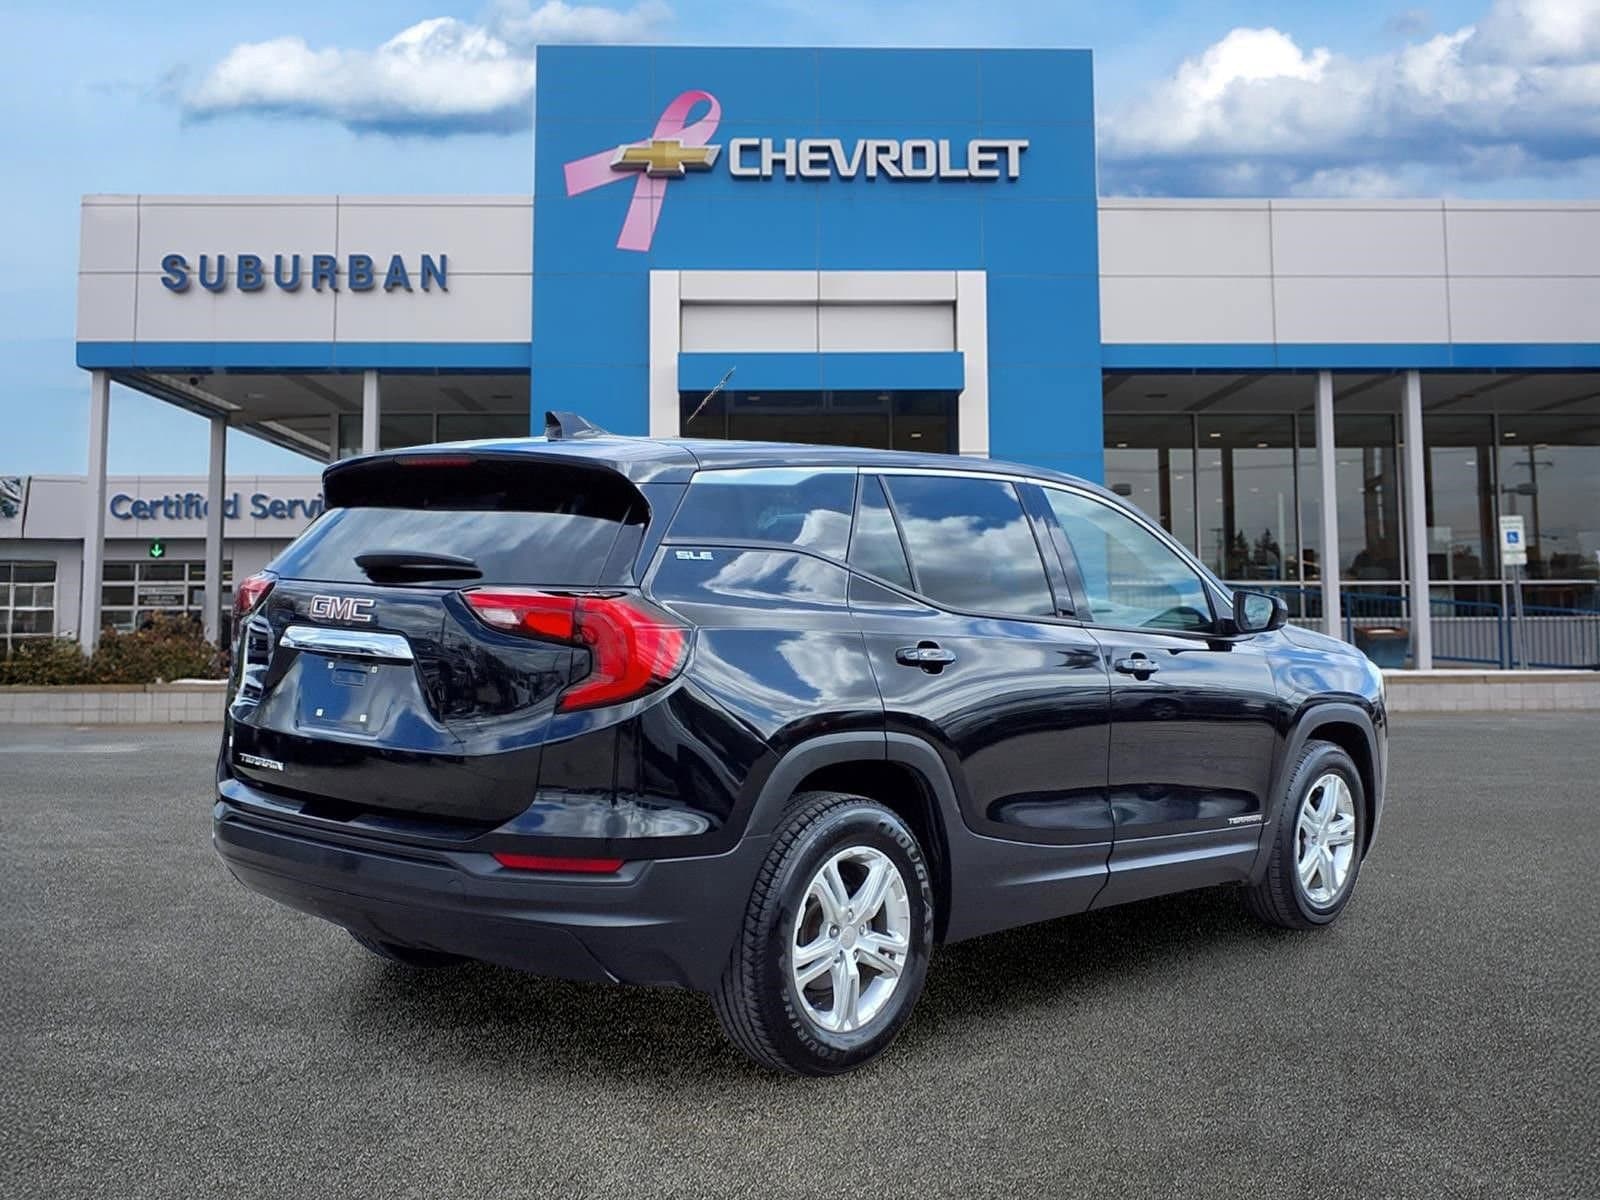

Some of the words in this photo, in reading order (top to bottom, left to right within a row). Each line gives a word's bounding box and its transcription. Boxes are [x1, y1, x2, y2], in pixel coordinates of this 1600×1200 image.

[729, 138, 1029, 180] CHEVROLET
[161, 254, 448, 291] SUBURBAN
[111, 493, 240, 520] Certifid
[251, 494, 324, 520] Servi
[676, 551, 713, 560] SLE
[310, 595, 374, 621] GMC
